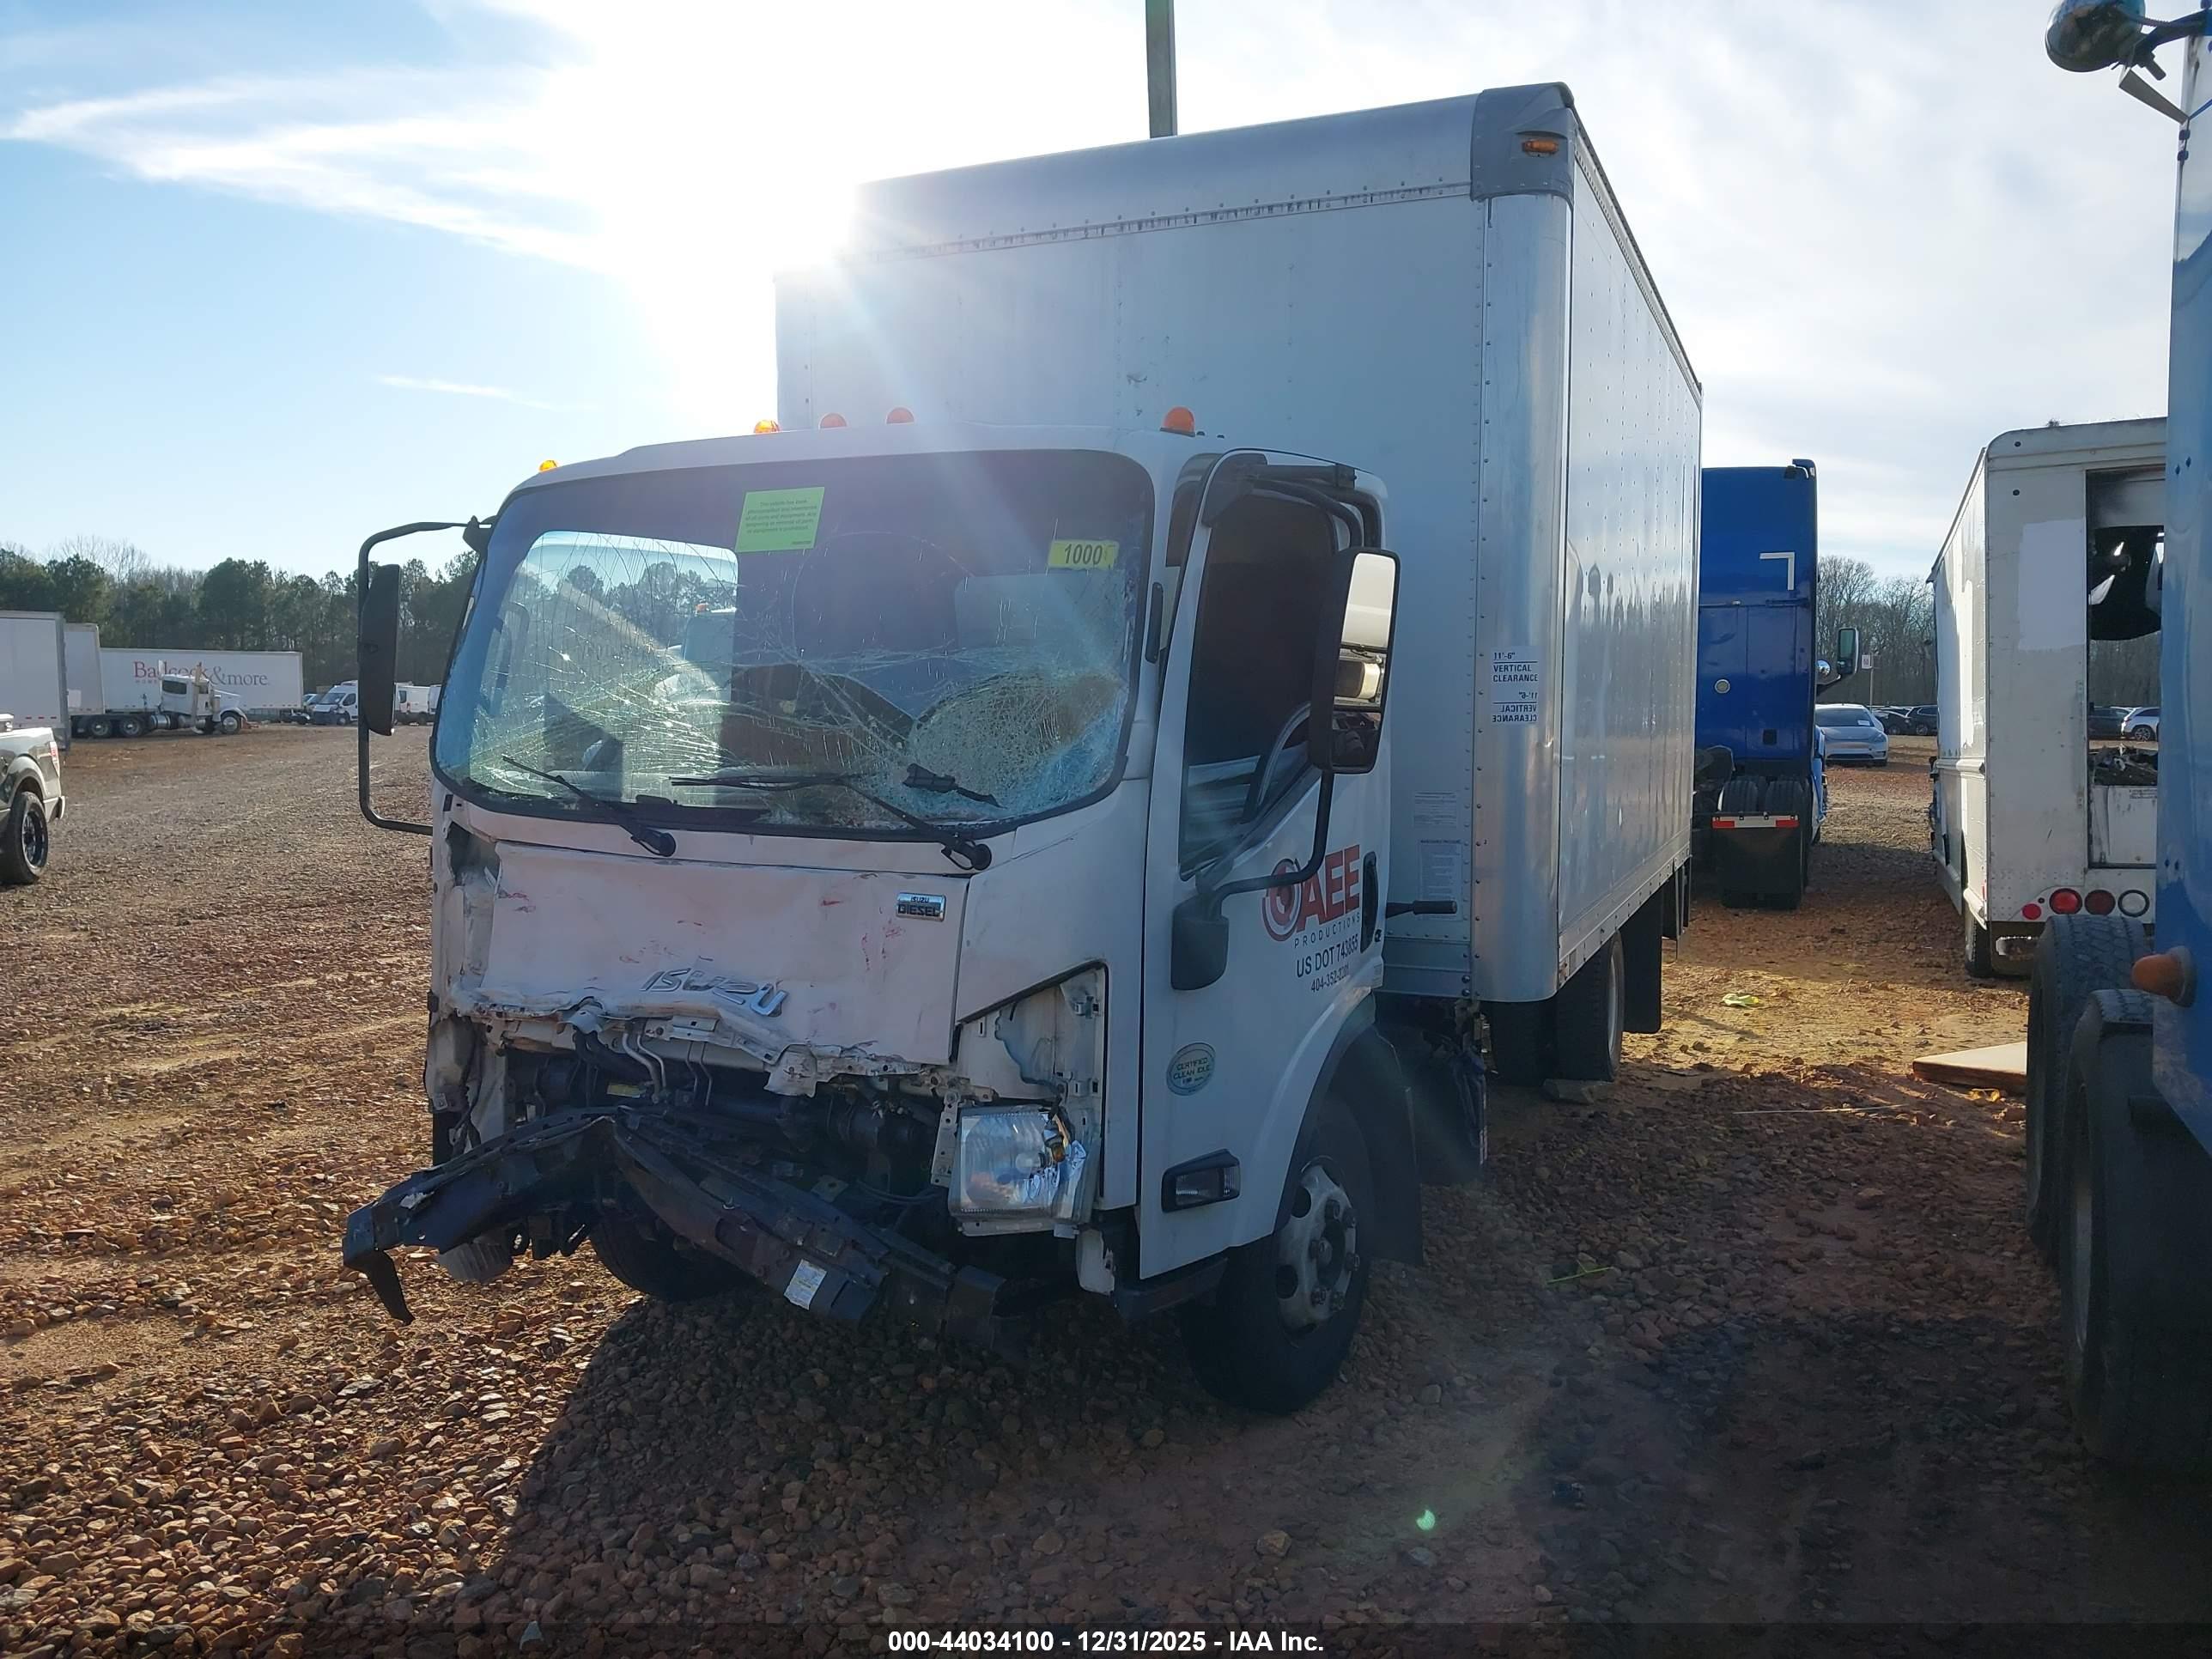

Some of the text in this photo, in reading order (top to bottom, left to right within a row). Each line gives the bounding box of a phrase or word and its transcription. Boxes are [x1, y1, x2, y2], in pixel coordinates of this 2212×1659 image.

[1064, 544, 1103, 565] 1000
[1492, 664, 1532, 672] VERTICAL
[1492, 674, 1539, 683] CLEARANCE
[897, 903, 941, 917] DIESEL
[1294, 912, 1360, 949] PRODUCTIONS
[1297, 956, 1312, 978] US
[1315, 945, 1334, 971] DOT
[639, 968, 789, 1017] ISUZU
[1173, 1070, 1195, 1080] CLEAN
